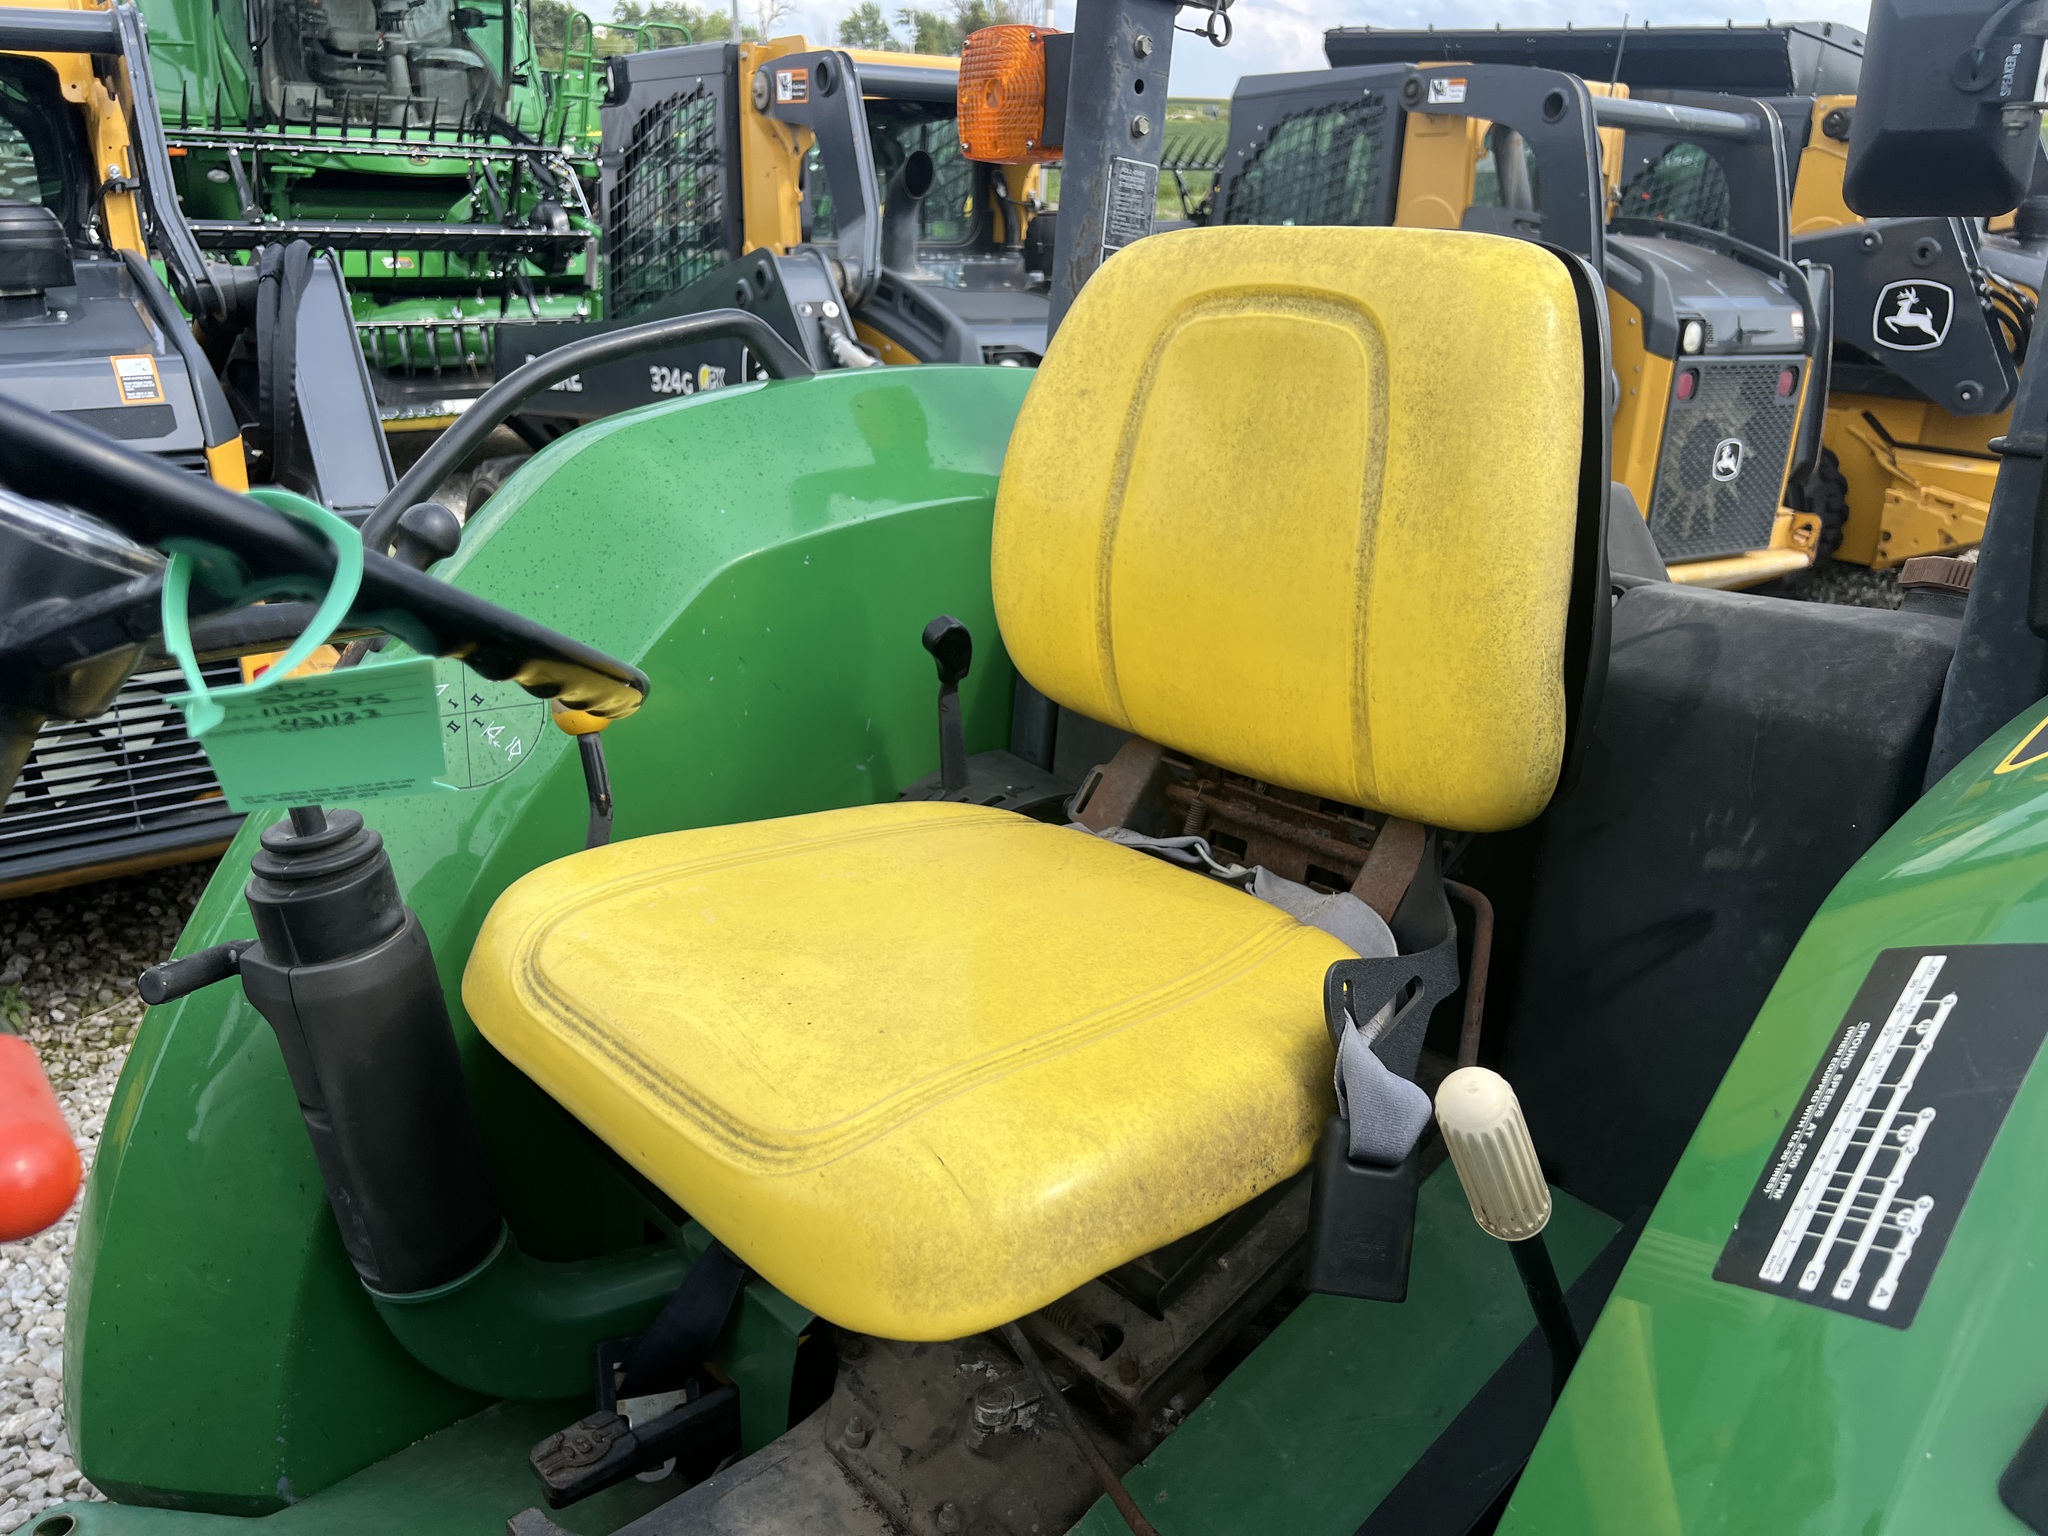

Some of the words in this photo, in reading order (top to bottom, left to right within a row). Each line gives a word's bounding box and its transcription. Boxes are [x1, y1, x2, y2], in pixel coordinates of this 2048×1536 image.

[2000, 55, 2017, 97] SPEAKER
[649, 365, 693, 395] 324G
[1834, 1025, 1855, 1056] (WHEN
[1839, 1022, 1871, 1070] GROUND
[1920, 1043, 1930, 1051] 2
[1810, 1056, 1839, 1103] EQUIPPED
[1814, 1073, 1844, 1118] SPEEDS
[1797, 1103, 1814, 1128] WITH
[1921, 1111, 1933, 1119] 3
[1804, 1122, 1818, 1139] AT
[1788, 1142, 1808, 1169] 2400
[1763, 1162, 1784, 1193] TIRES)
[1772, 1173, 1793, 1200] RPM
[1898, 1212, 1912, 1223] R
[1919, 1201, 1931, 1209] 3
[1906, 1227, 1918, 1235] 2
[1806, 1270, 1817, 1280] C
[1840, 1279, 1853, 1289] B
[1876, 1287, 1890, 1298] A
